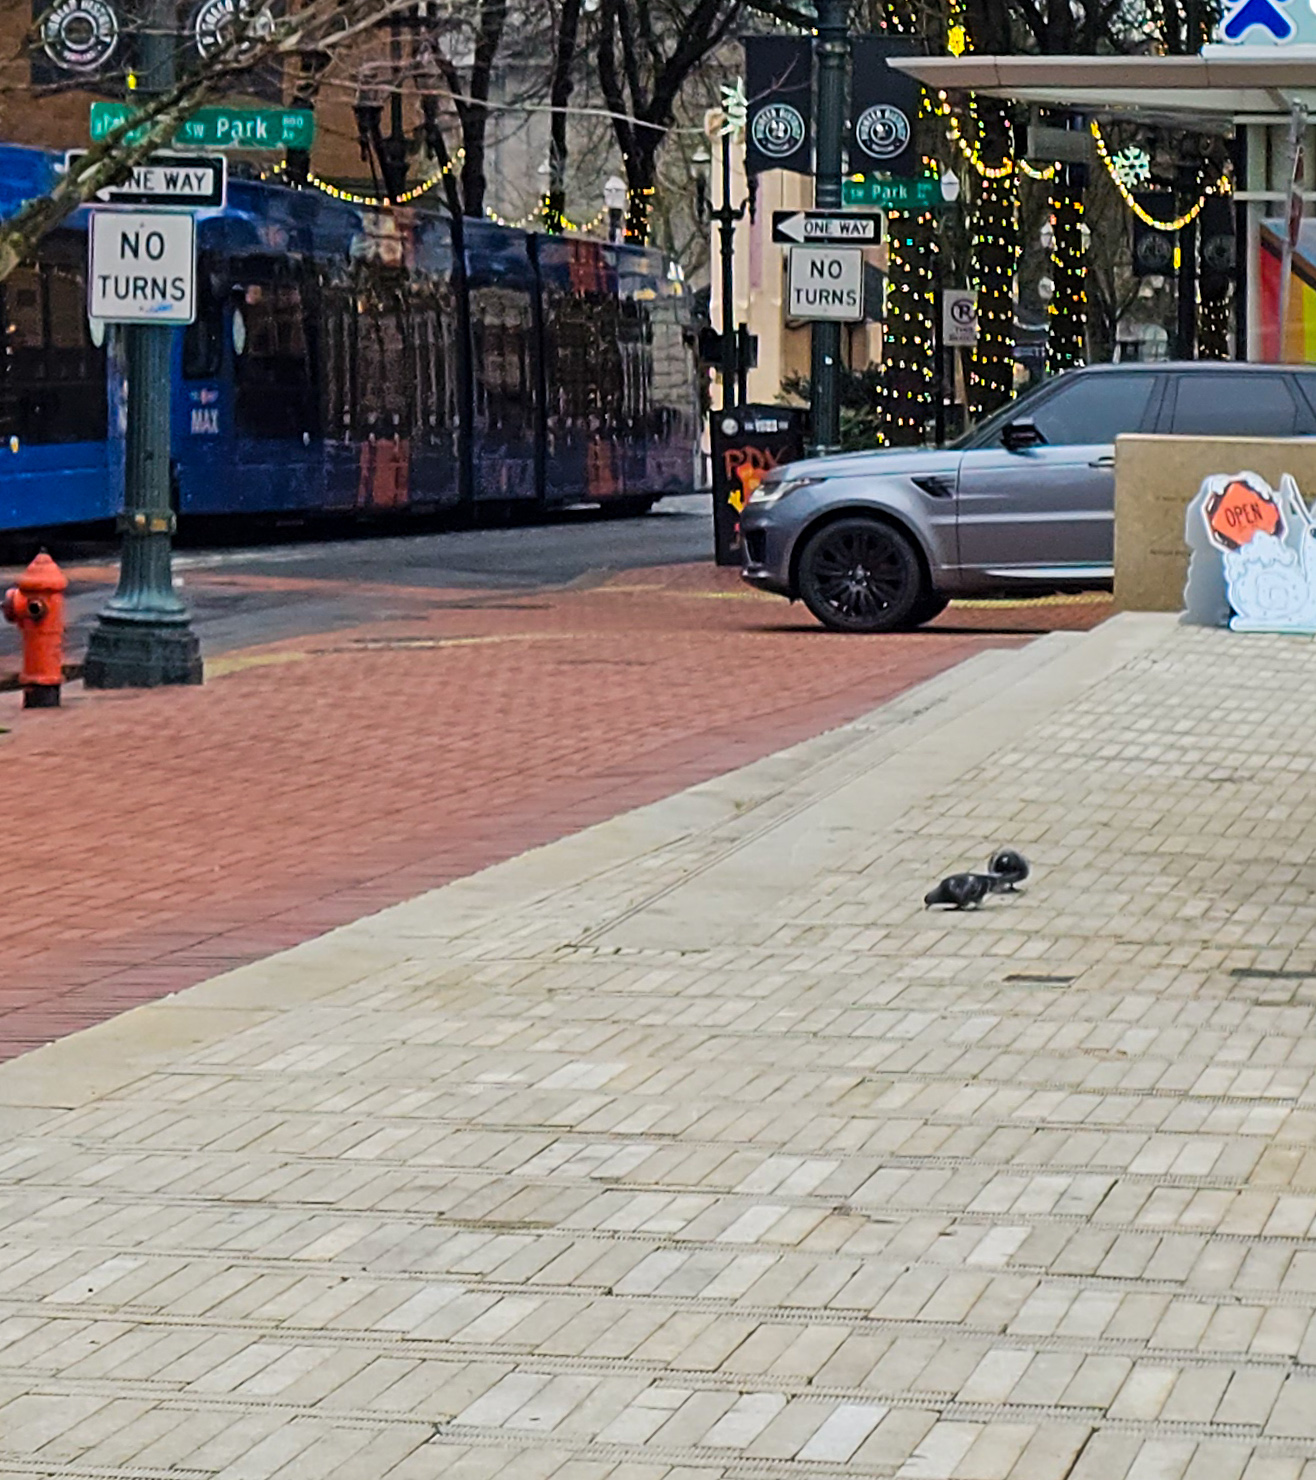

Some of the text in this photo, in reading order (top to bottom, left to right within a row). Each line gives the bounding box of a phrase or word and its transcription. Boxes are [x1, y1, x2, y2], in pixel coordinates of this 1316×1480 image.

[185, 116, 268, 139] SW Park
[124, 171, 206, 192] NE WAY
[872, 183, 908, 200] Park
[804, 221, 871, 236] ONE WAY
[120, 230, 165, 261] NO
[810, 259, 843, 280] NO
[98, 275, 186, 302] TURNS
[795, 288, 857, 307] TURNS
[191, 408, 219, 435] MAX
[1224, 502, 1264, 528] OPEN
